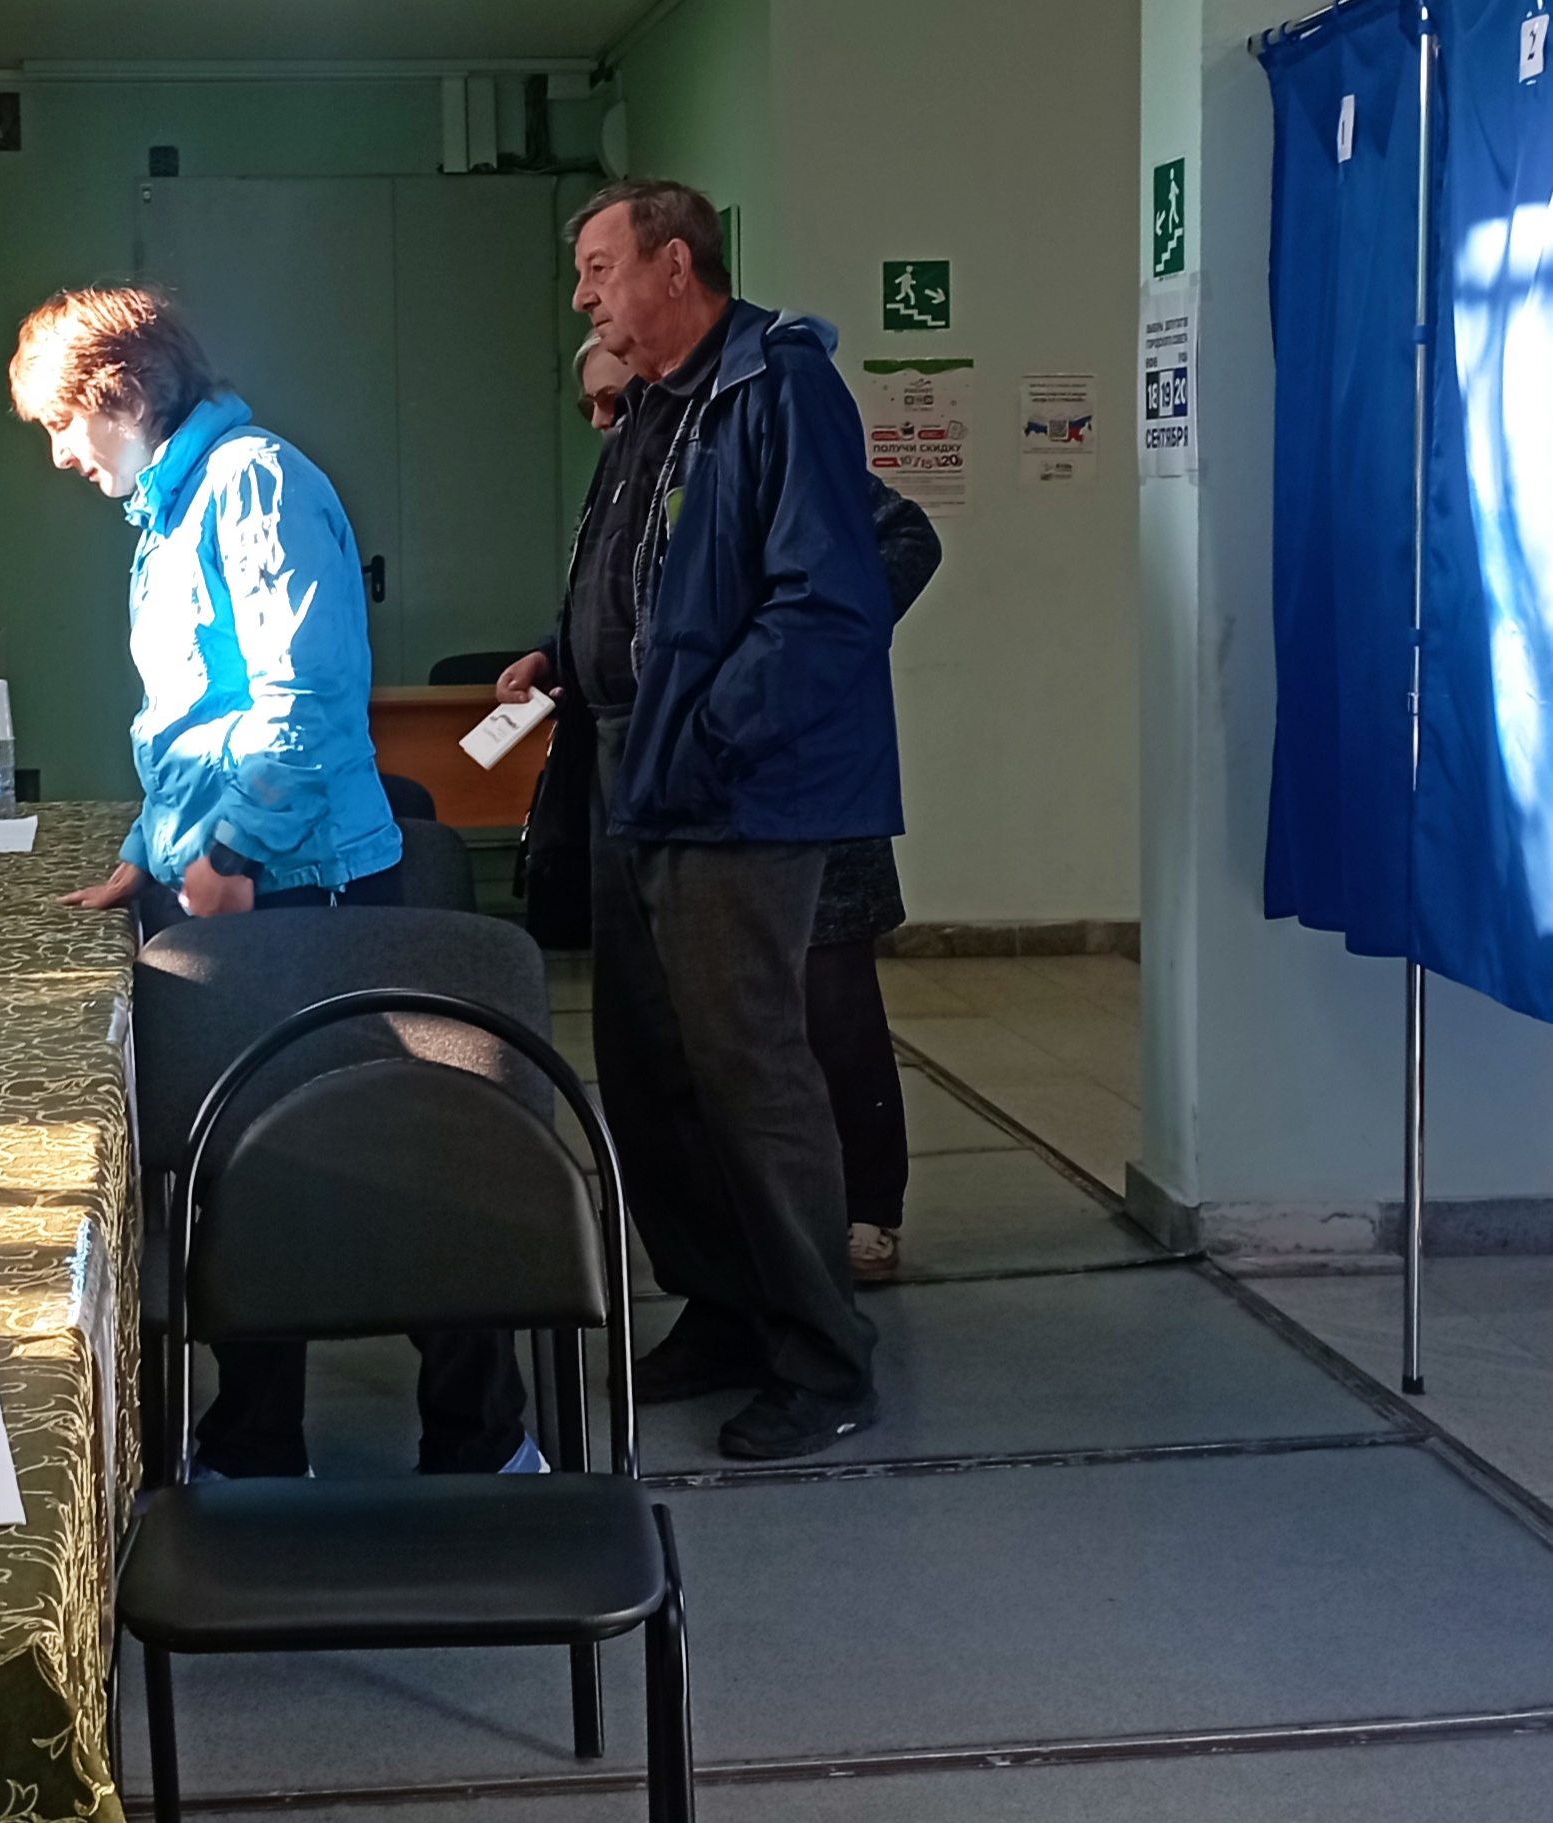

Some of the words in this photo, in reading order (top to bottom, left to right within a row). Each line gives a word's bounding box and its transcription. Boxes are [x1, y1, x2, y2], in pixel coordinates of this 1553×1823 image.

[1147, 382, 1158, 410] 18
[1160, 379, 1172, 408] 19
[1174, 377, 1186, 405] 20
[873, 443, 917, 453] ПОЛУЧИ
[919, 443, 962, 453] СКИДКУ
[1145, 425, 1189, 449] СЕНТЯБРЯ
